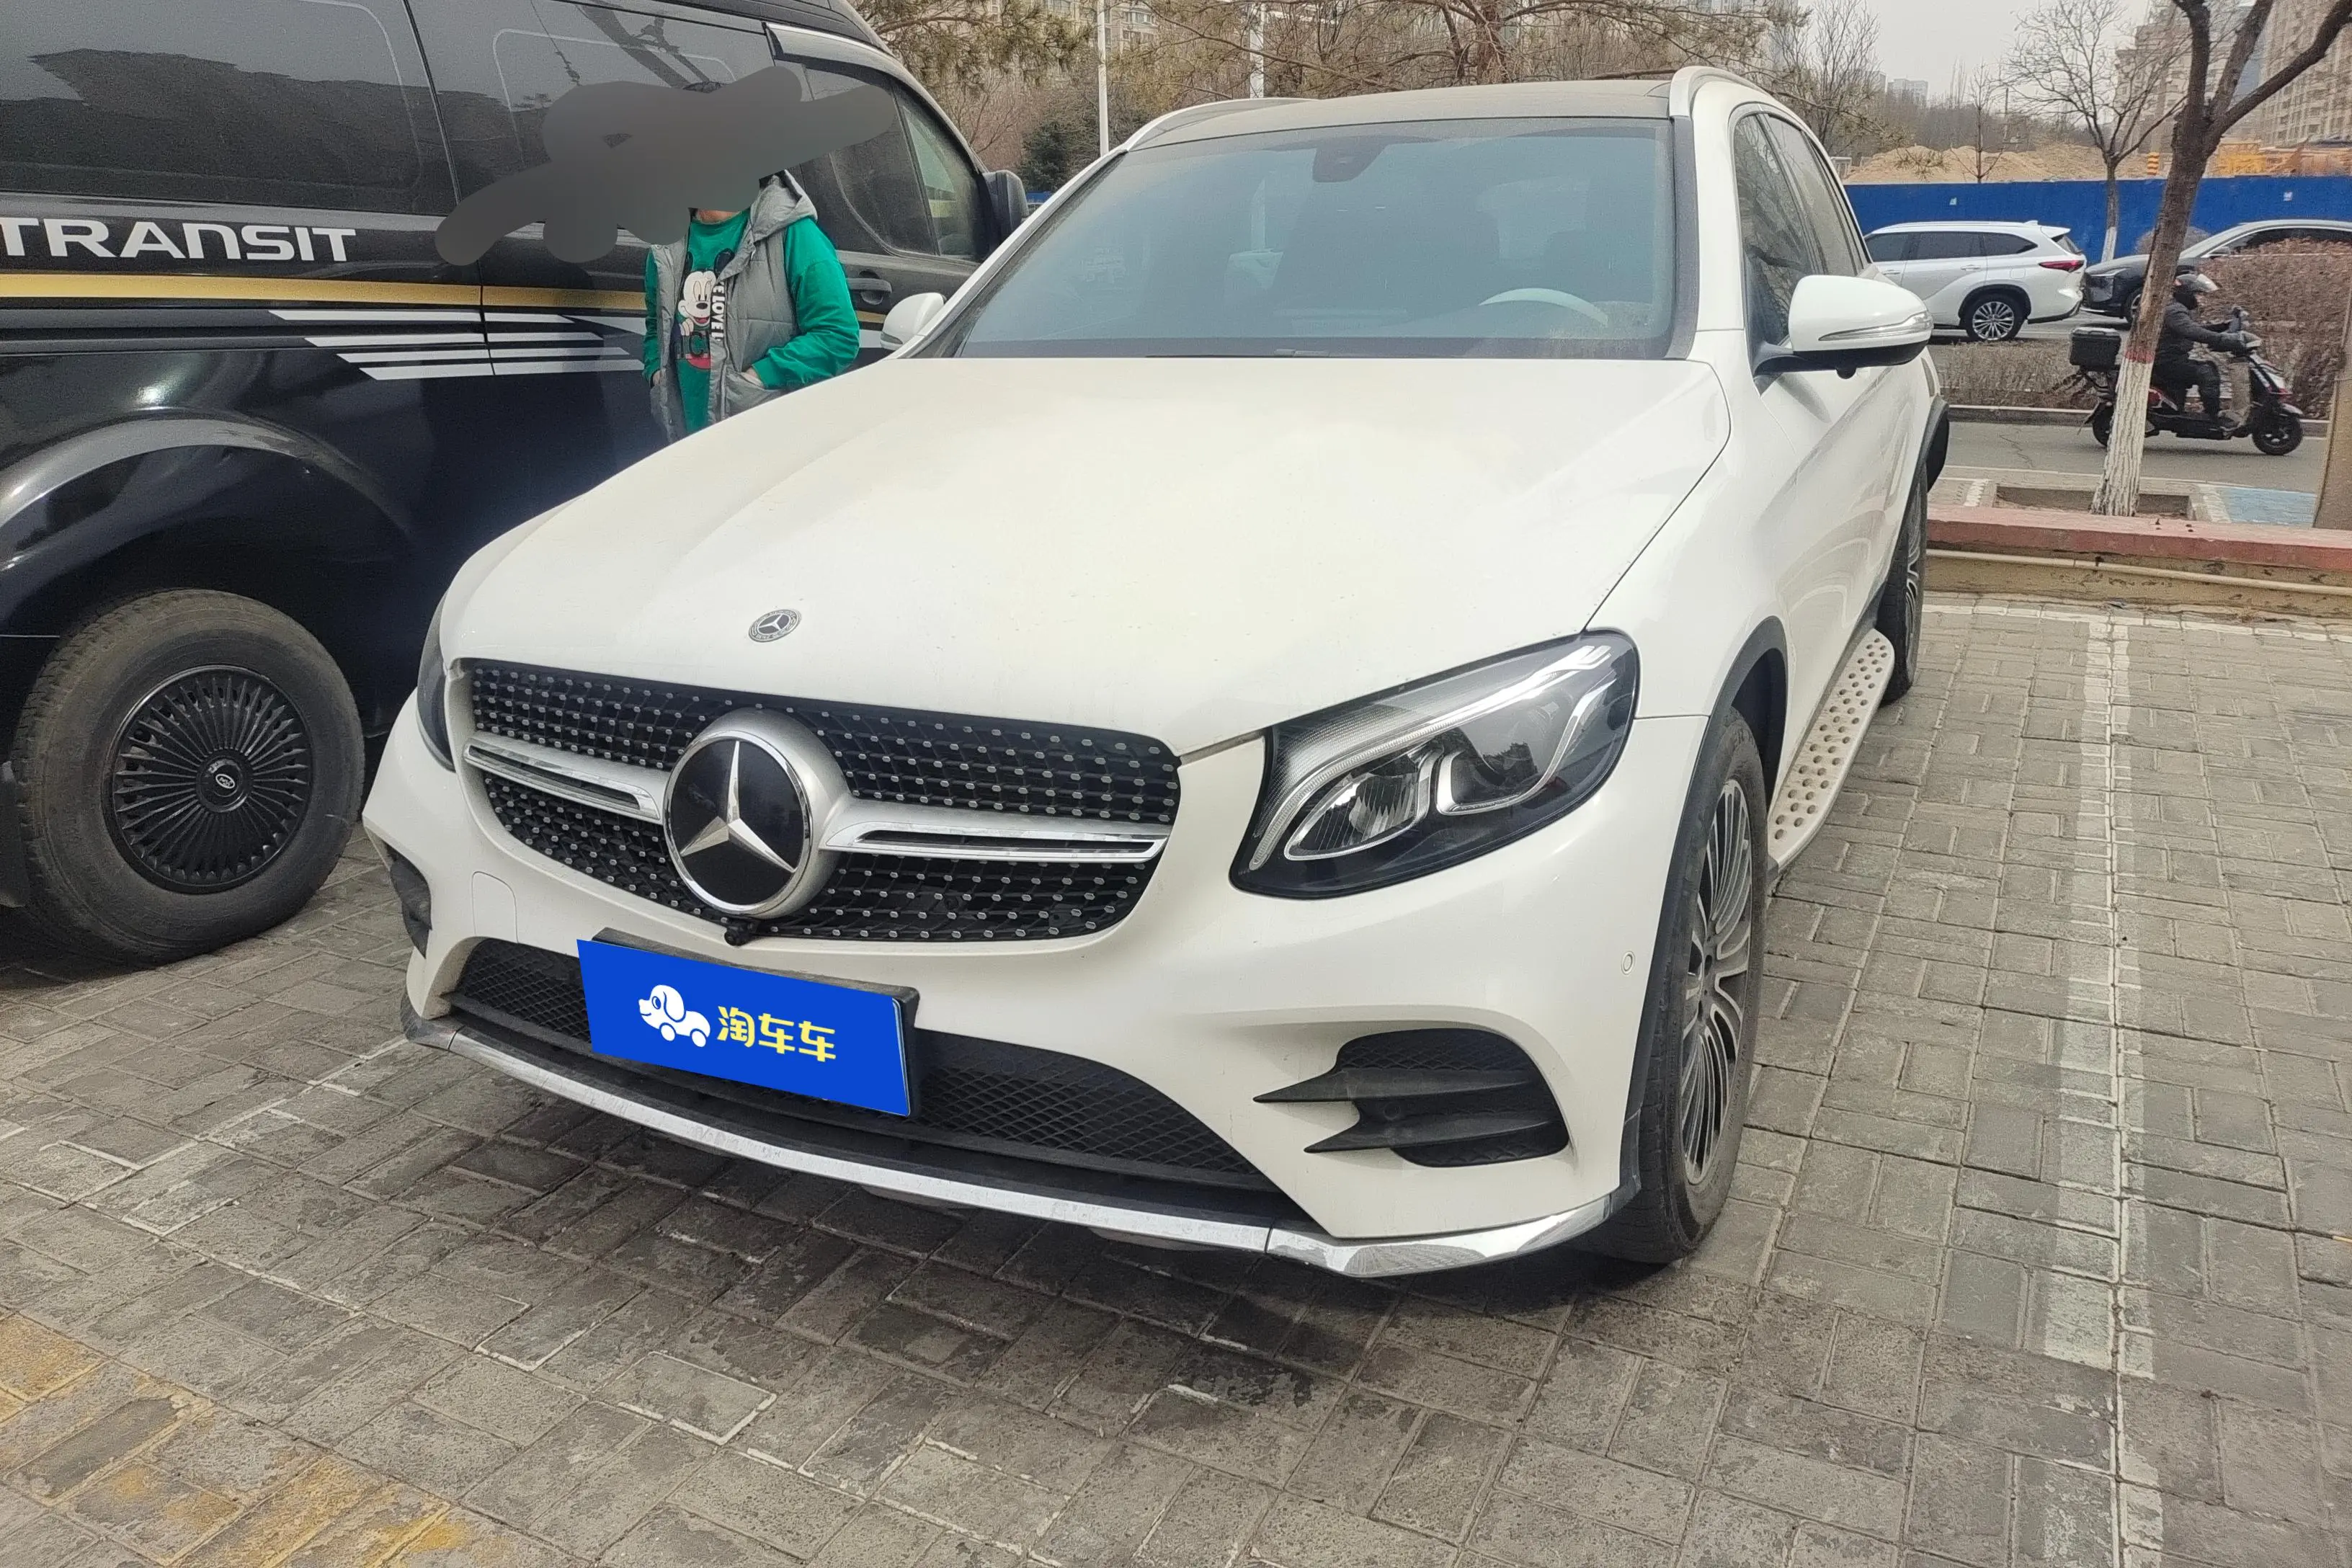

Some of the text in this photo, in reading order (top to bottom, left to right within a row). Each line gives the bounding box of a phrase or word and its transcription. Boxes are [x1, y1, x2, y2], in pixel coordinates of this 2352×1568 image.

[0, 217, 357, 262] TRANSIT
[712, 281, 725, 293] E
[710, 295, 726, 329] LOVE
